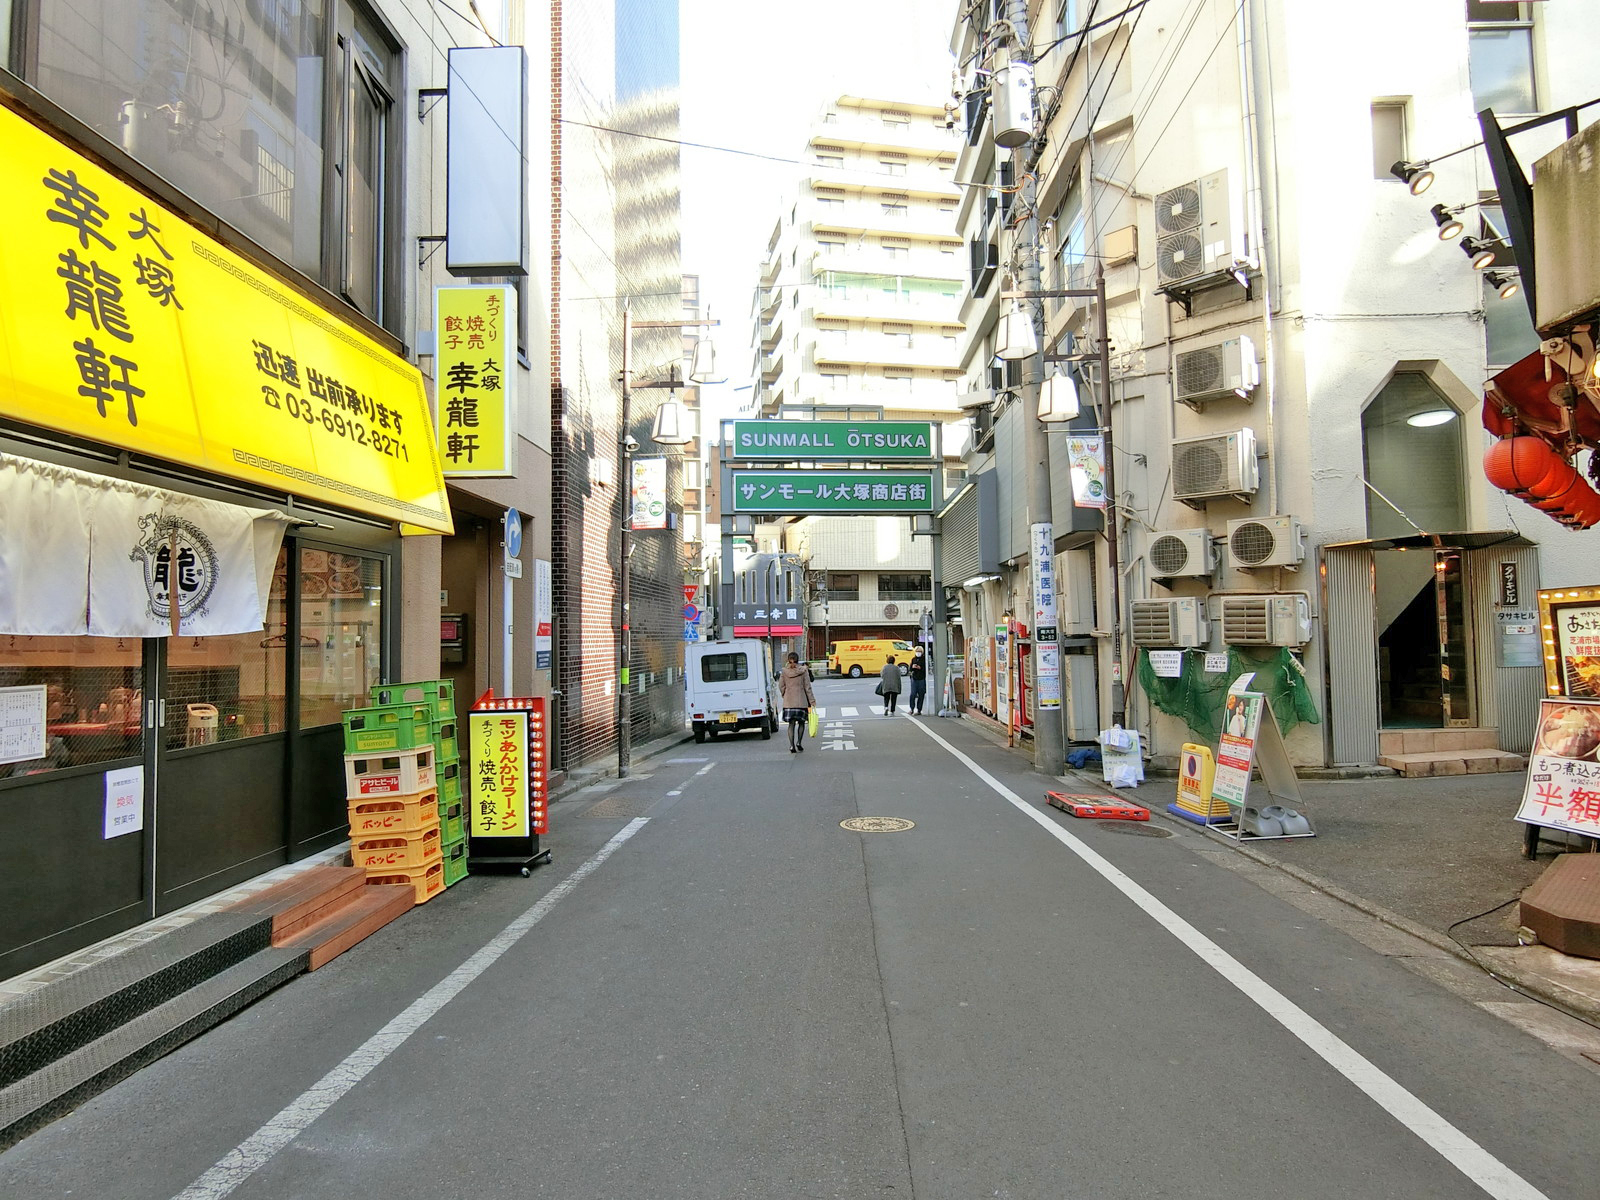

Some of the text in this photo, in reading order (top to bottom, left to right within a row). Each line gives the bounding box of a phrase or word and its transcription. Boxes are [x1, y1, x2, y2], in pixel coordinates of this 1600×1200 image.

[128, 207, 184, 310] 大塚
[43, 168, 145, 427] 幸龍軒
[444, 315, 464, 350] 餃子
[466, 315, 486, 350] 焼売
[486, 295, 500, 343] 手づくり
[252, 339, 404, 435] 迅速 出前承ります
[481, 358, 502, 392] 大塚
[286, 392, 410, 463] 03-6912-8271
[446, 362, 480, 464] 幸龍軒
[741, 432, 835, 448] SUNMALL
[740, 483, 926, 502] サンモール大塚商店街
[153, 545, 200, 593] 龍
[1038, 527, 1052, 607] 十九浦医院
[849, 644, 877, 652] DHL
[363, 740, 391, 748] SUNTORY
[360, 778, 399, 788] アサヒビール
[499, 719, 519, 831] モツあんかけラーメン
[1539, 759, 1600, 780] もつ煮込み
[114, 813, 136, 827] 営業中
[1533, 783, 1600, 826] 半額
[362, 816, 403, 830] ホッピー
[365, 852, 406, 866] ホッピー
